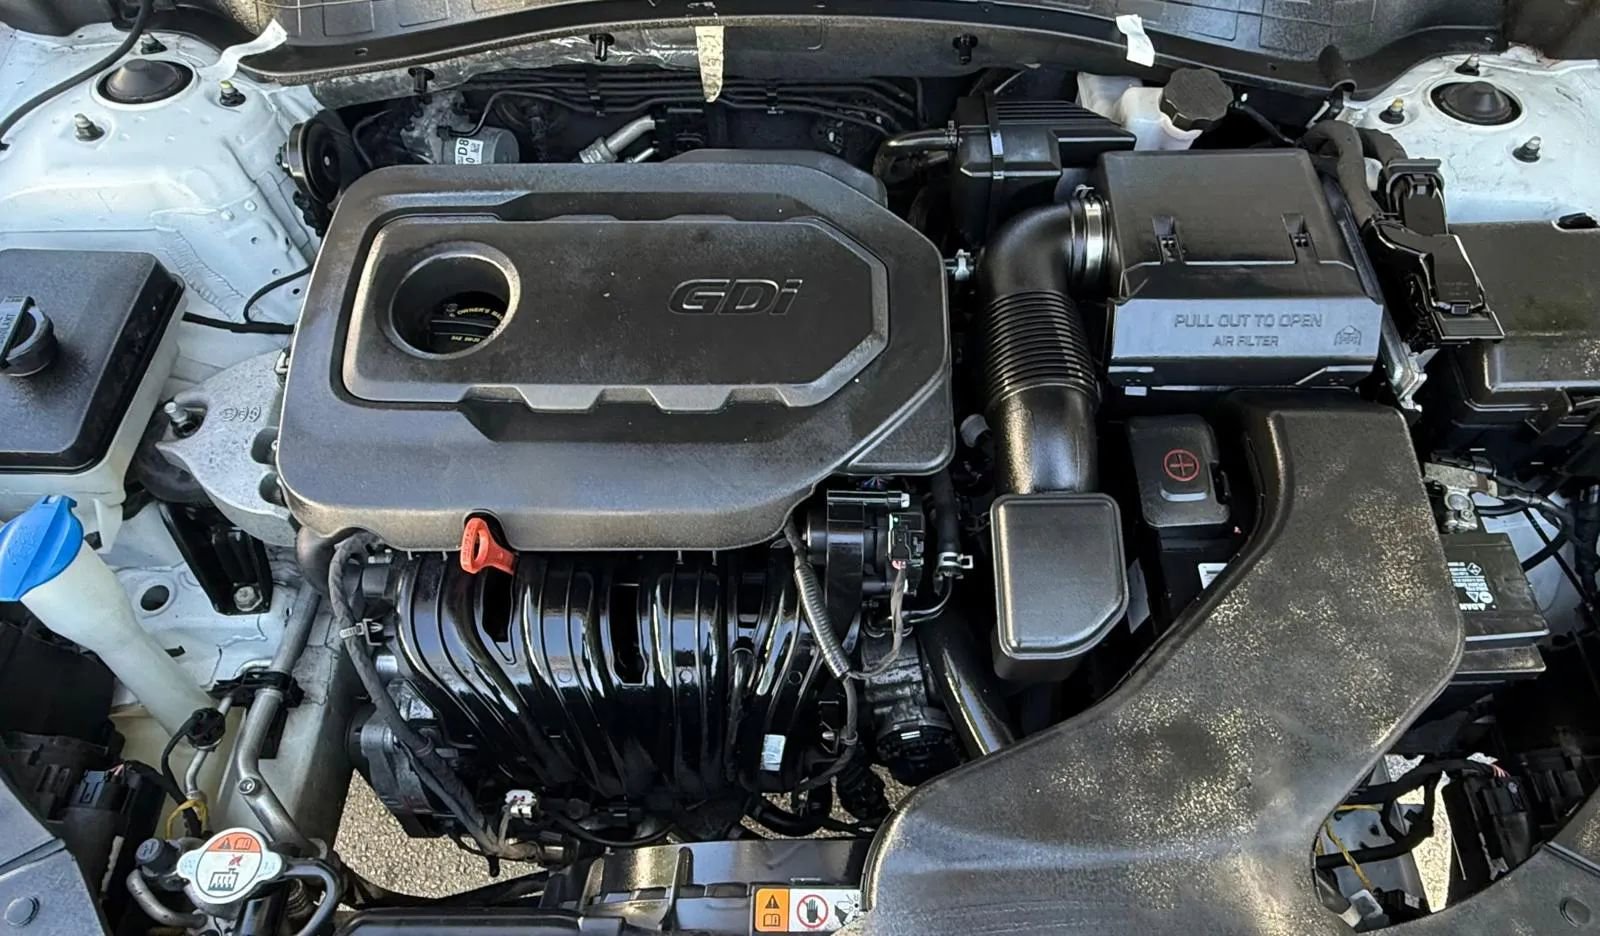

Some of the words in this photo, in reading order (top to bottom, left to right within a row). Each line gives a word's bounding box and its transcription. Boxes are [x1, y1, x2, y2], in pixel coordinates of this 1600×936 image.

[457, 139, 469, 156] D8
[667, 278, 804, 315] GDi
[1174, 313, 1214, 328] PULL
[1218, 313, 1250, 328] OUT
[1255, 313, 1275, 328] TO
[1279, 313, 1322, 328] OPEN
[1212, 335, 1234, 347] AIR
[1237, 335, 1279, 347] FILTER
